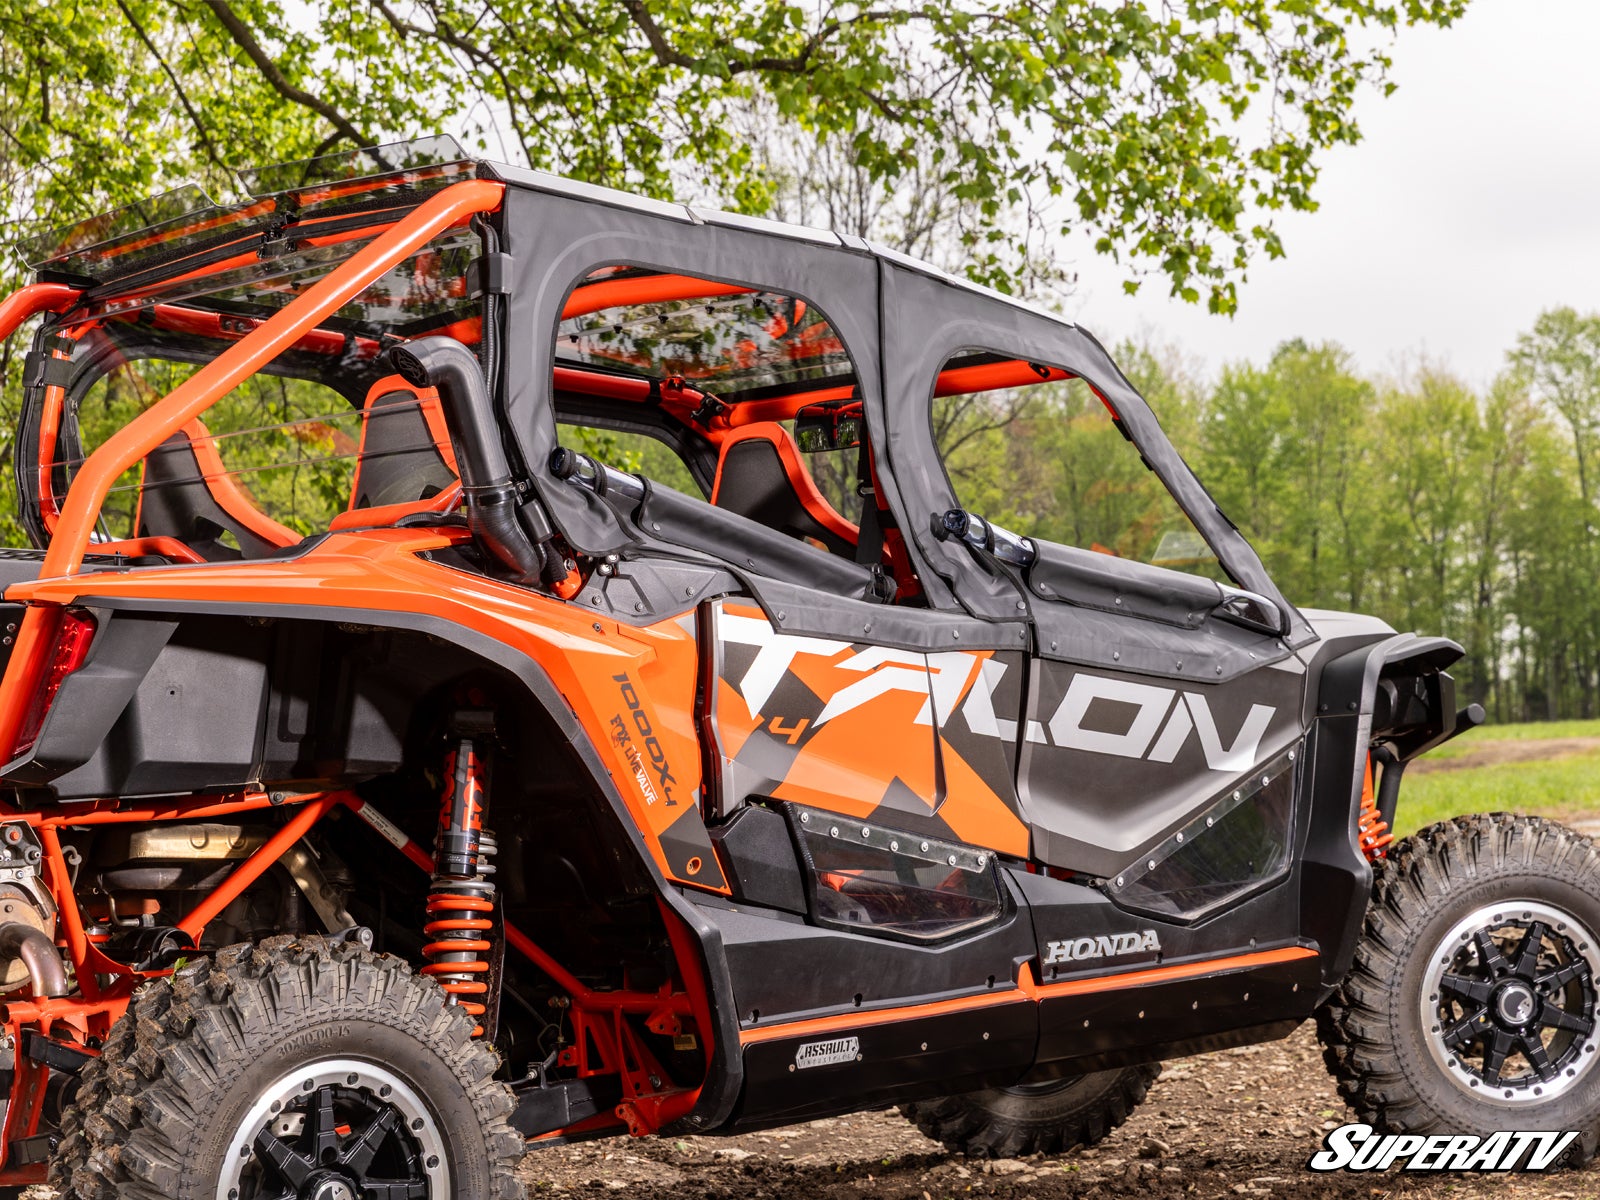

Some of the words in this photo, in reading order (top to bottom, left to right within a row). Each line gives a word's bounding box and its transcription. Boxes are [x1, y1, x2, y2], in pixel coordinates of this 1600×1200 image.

[718, 614, 1277, 772] TALON
[1043, 929, 1162, 964] HONDA
[804, 1040, 853, 1058] ASSAULT
